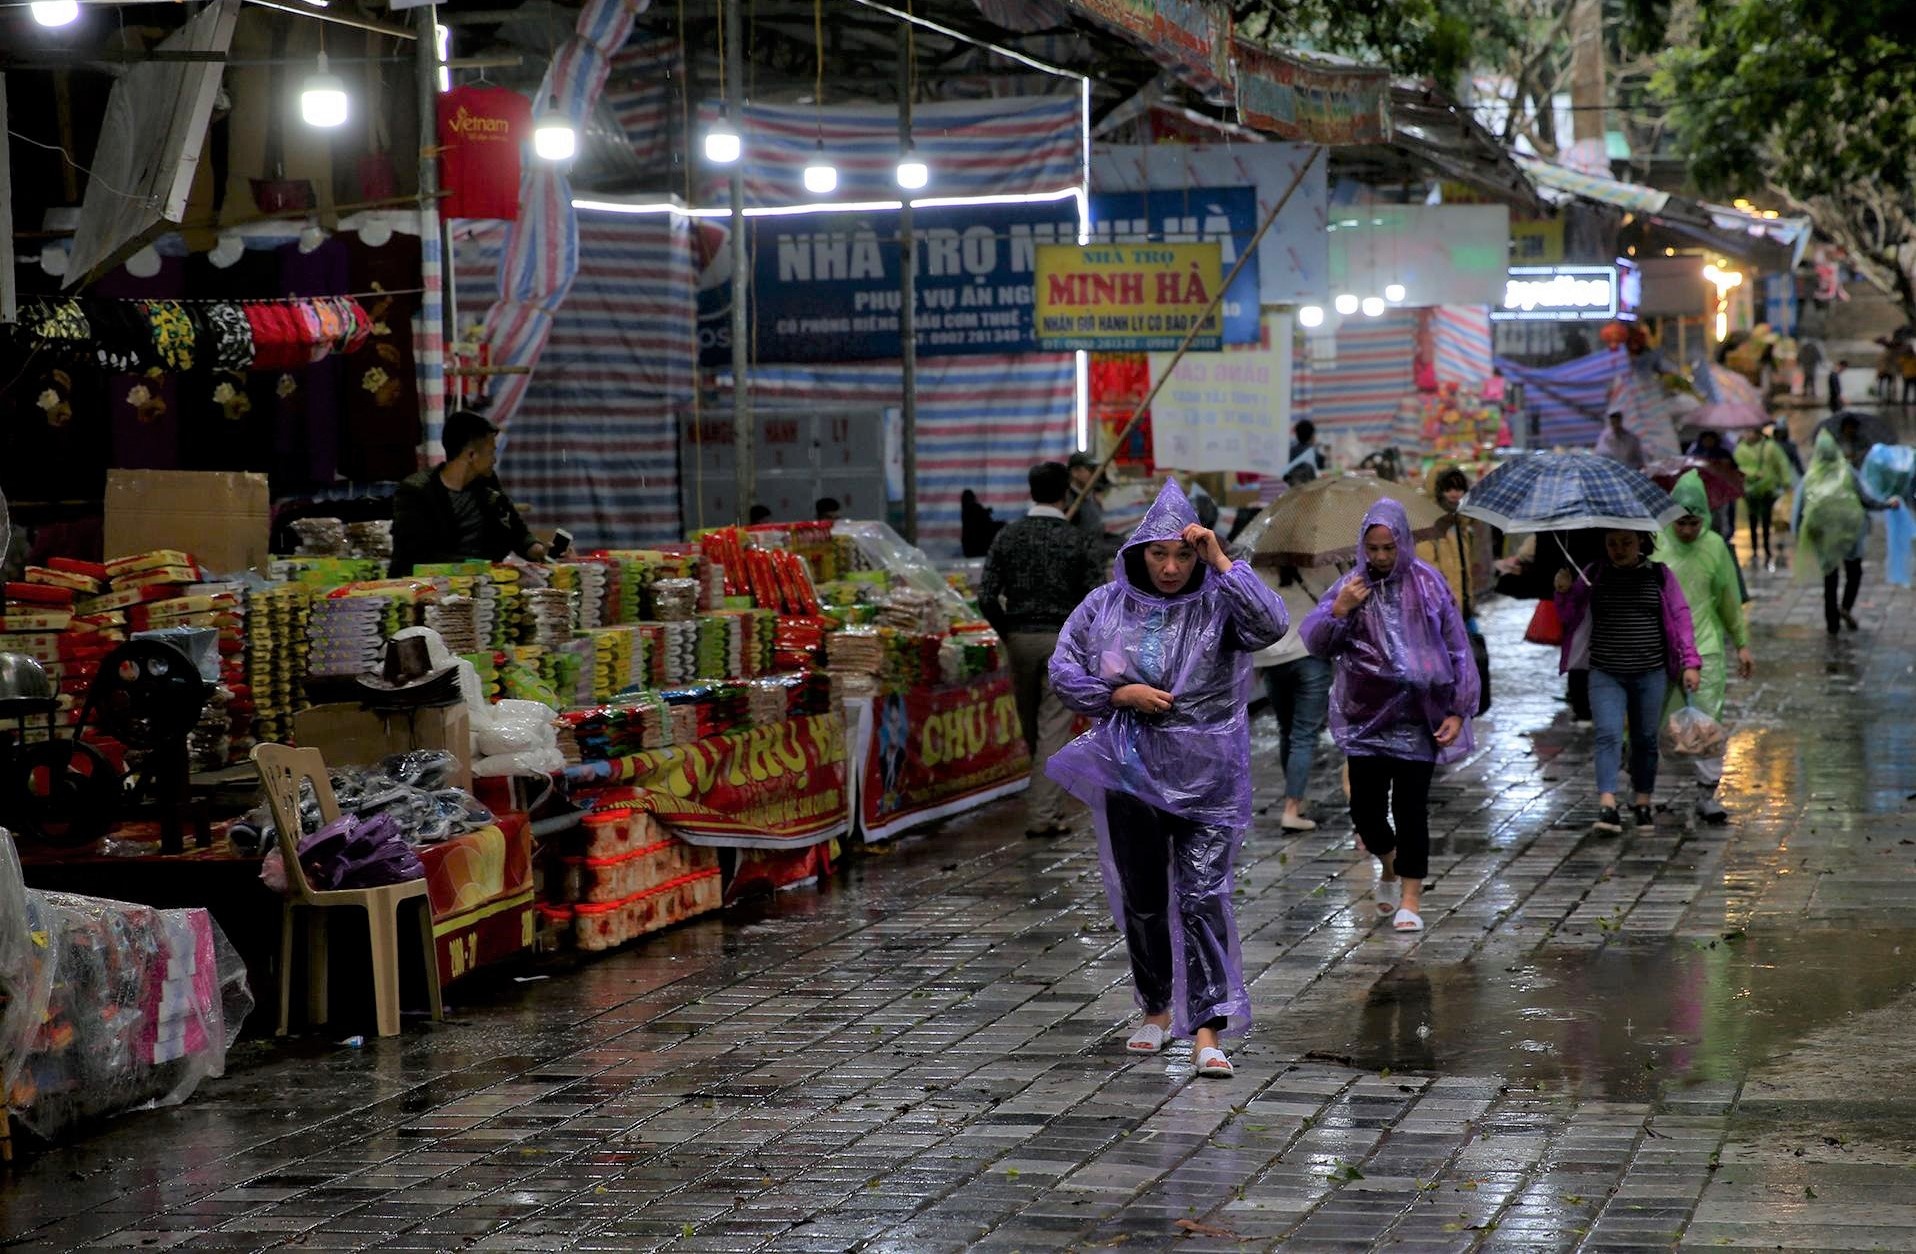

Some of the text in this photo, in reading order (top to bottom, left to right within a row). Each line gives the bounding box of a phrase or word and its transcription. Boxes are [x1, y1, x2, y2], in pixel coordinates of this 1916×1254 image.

[777, 222, 885, 281] NHÀ
[1082, 249, 1174, 268] NHÀ TRỌ
[999, 284, 1036, 305] NG
[1047, 261, 1209, 306] MINH HÀ
